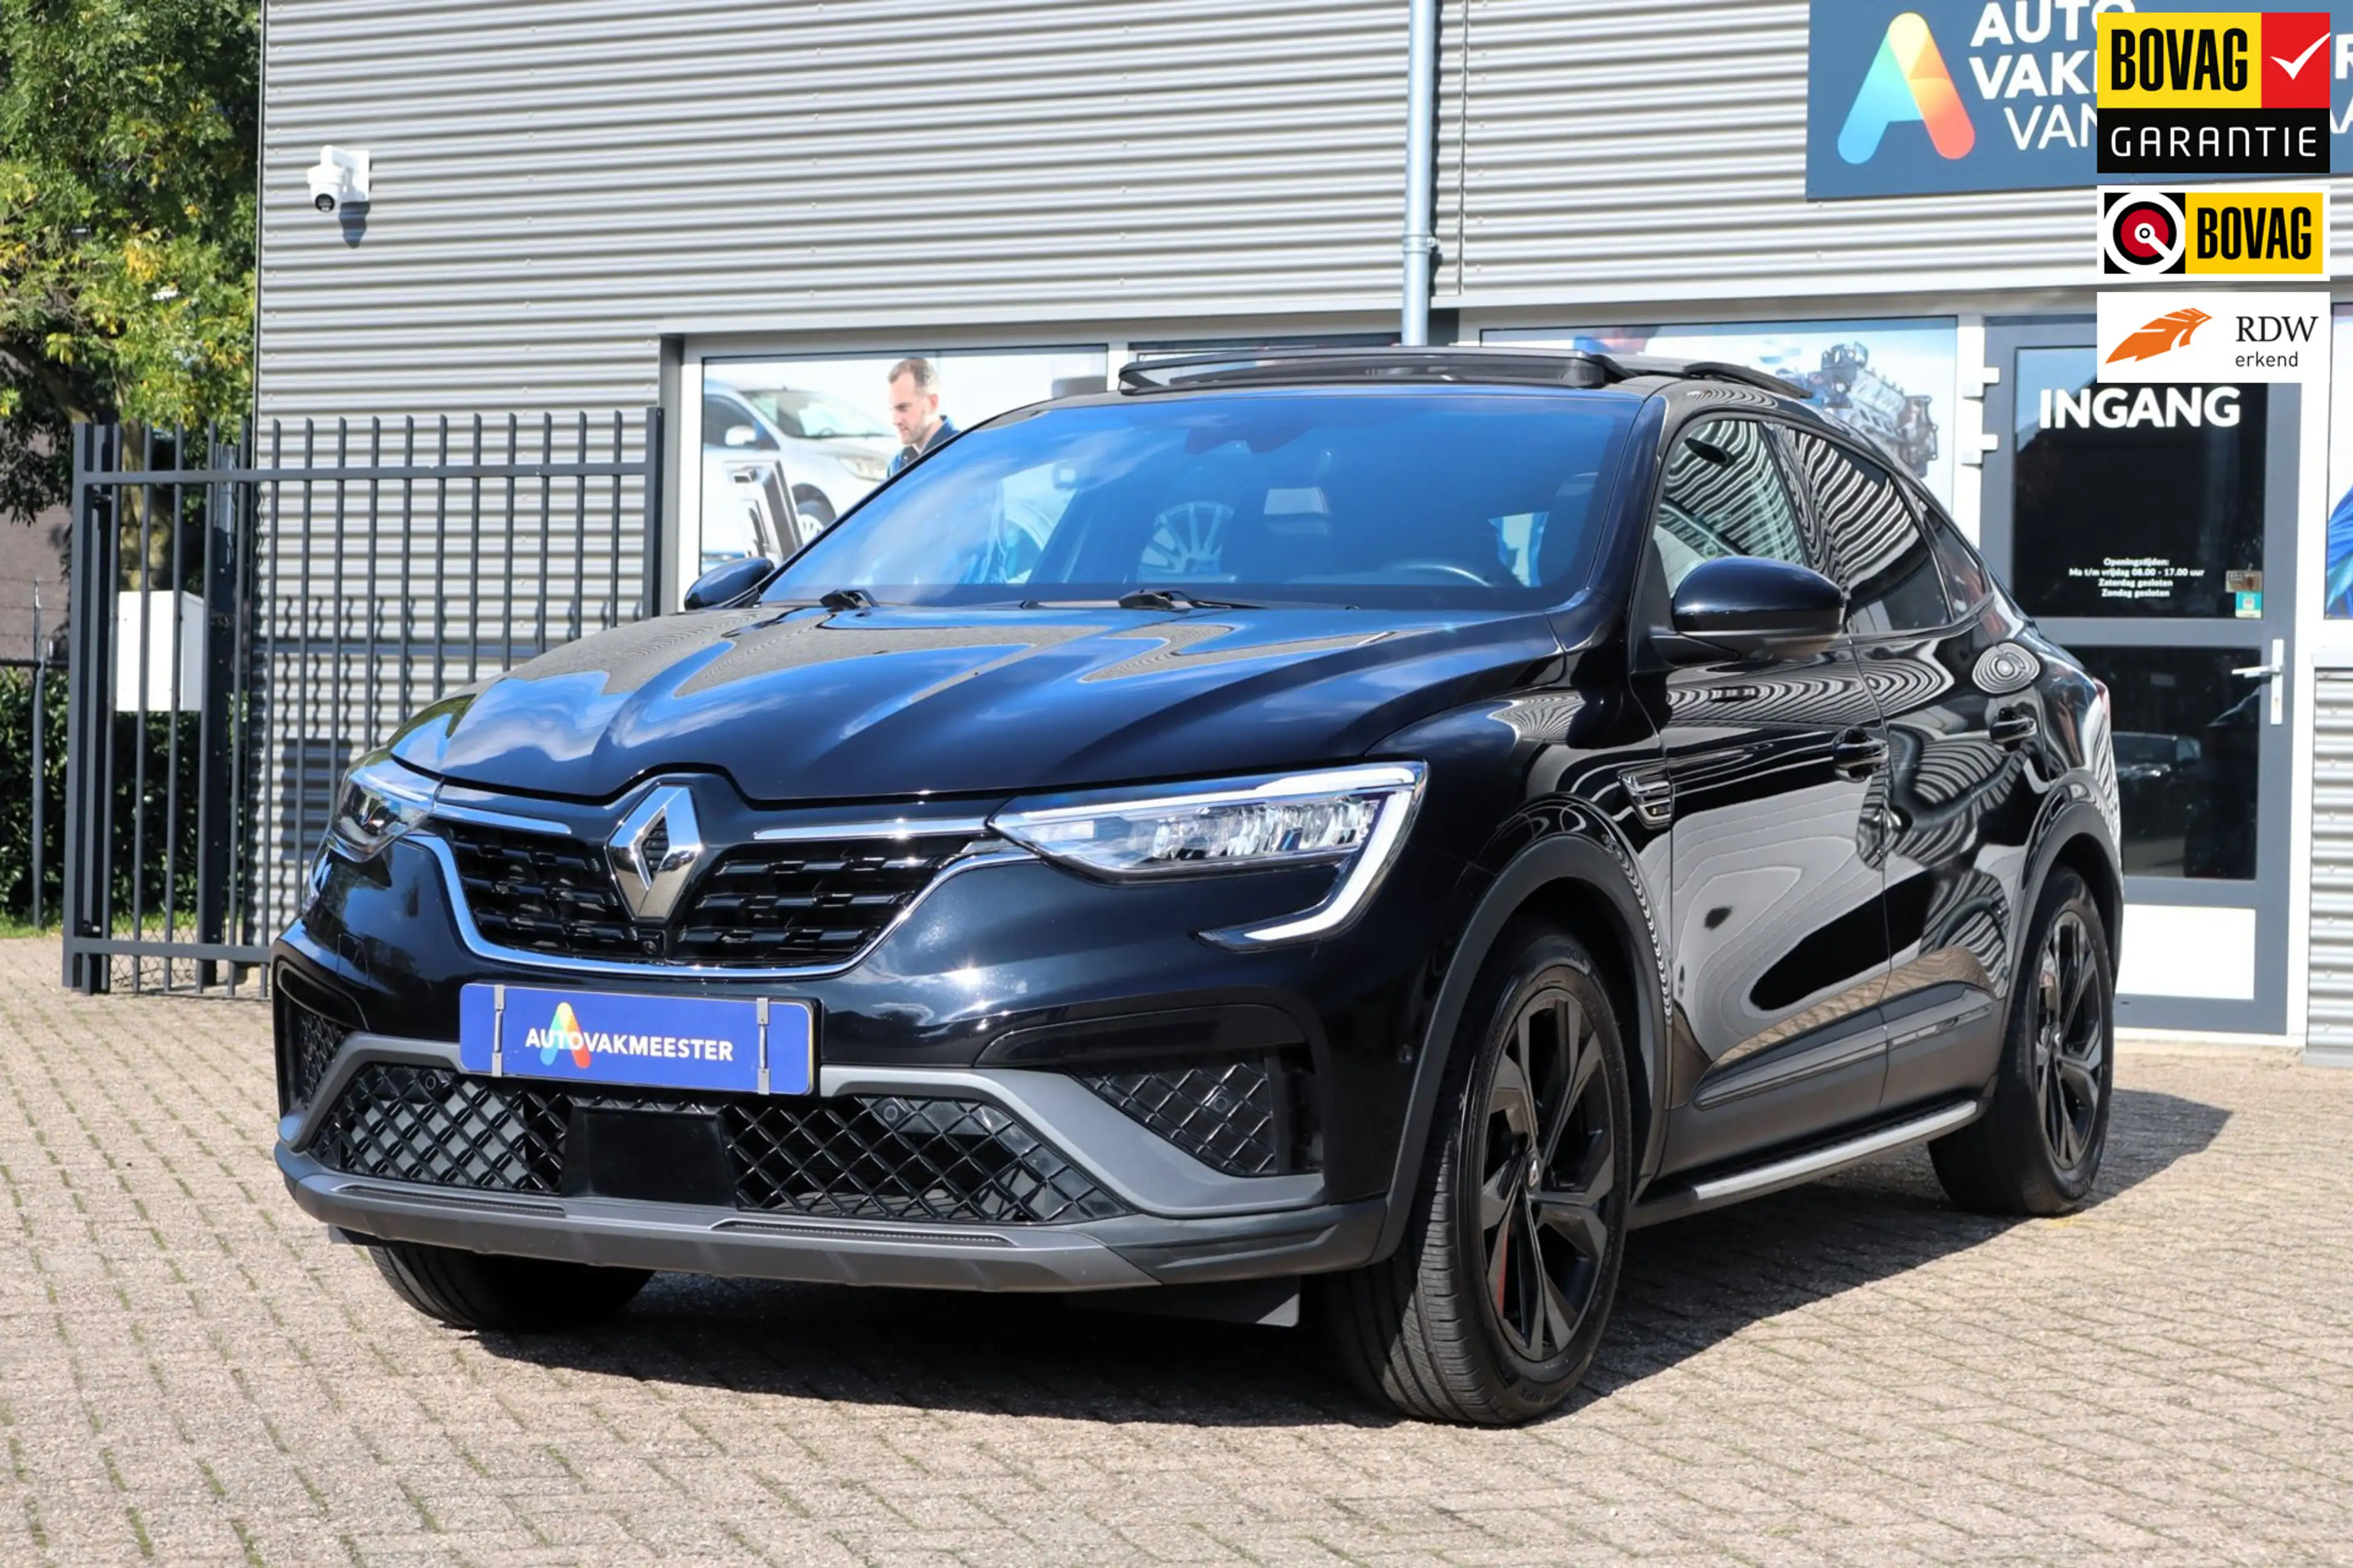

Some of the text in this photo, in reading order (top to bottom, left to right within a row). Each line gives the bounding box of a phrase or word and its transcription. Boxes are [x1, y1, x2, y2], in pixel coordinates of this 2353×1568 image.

[1968, 50, 2097, 99] VAK
[2039, 386, 2240, 428] INGANG
[2103, 558, 2170, 567] Openingstijden:
[2069, 568, 2083, 577] Ma
[2084, 568, 2100, 577] t/m
[2101, 568, 2131, 578] vrijdag
[2164, 568, 2188, 577] 17.00
[2098, 578, 2173, 588] Zaterdag gesloten
[2101, 589, 2170, 598] Zondag gesloten
[525, 1028, 734, 1062] AUTOVAKMEESTER
